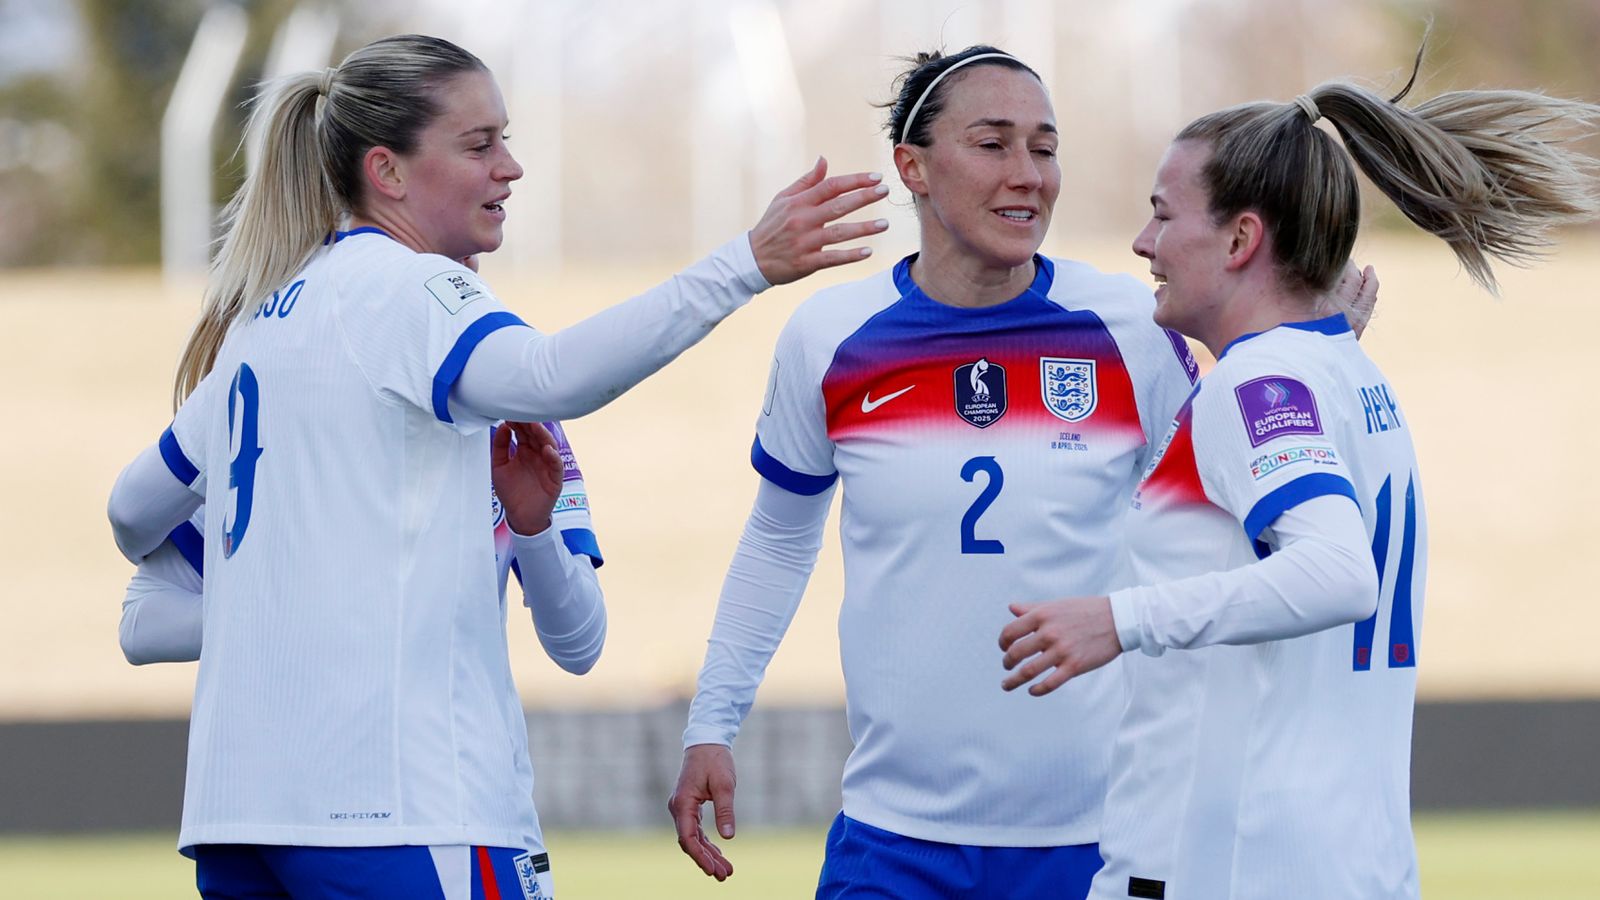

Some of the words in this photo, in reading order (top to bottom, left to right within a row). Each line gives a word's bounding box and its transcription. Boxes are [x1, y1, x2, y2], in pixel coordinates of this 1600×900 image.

[1254, 412, 1311, 429] EUROPEAN
[1256, 419, 1315, 436] QUALIFIERS
[222, 362, 264, 560] 9
[1251, 449, 1336, 478] FOUNDATION
[960, 456, 1005, 554] 2
[1353, 468, 1416, 672] 11
